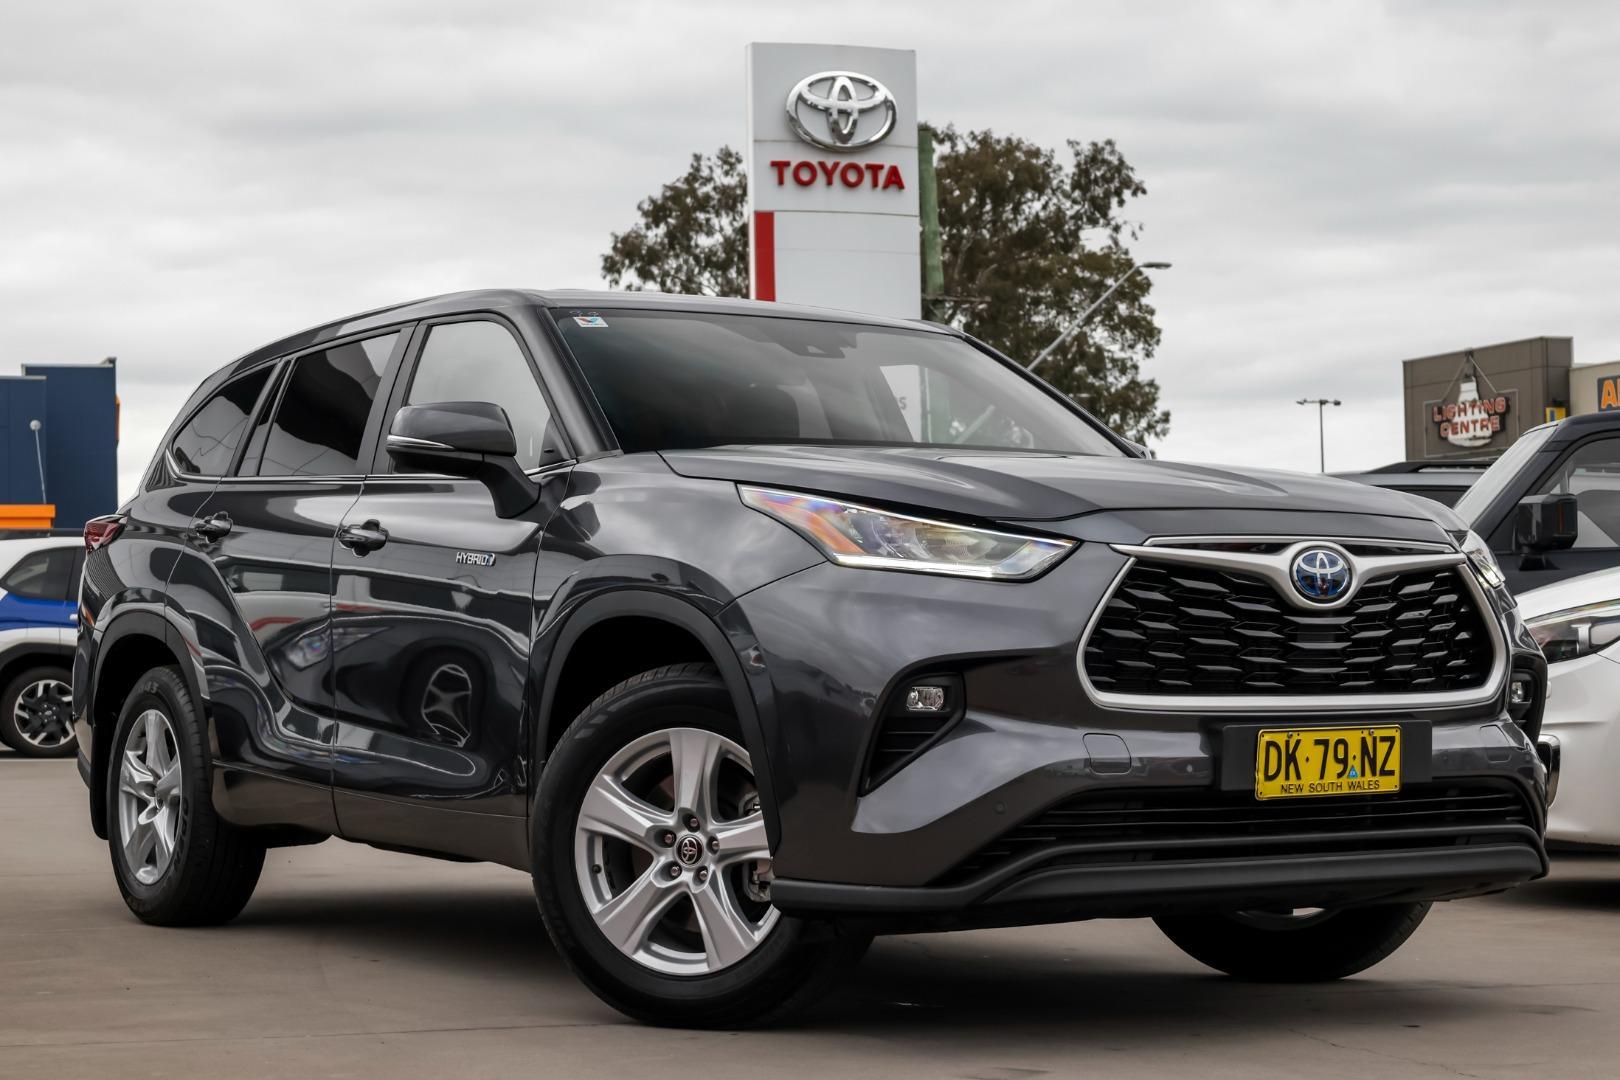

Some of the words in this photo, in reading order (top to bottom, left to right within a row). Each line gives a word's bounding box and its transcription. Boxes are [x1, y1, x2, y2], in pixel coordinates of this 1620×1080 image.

[770, 160, 905, 190] TOYOTA
[1601, 379, 1620, 409] A
[1434, 397, 1506, 422] LIGHTING
[1440, 415, 1500, 437] CENTRE
[455, 552, 488, 566] HYBRID
[1280, 783, 1304, 794] NEW
[1308, 781, 1343, 793] SOUTH
[1347, 780, 1380, 790] WALES
